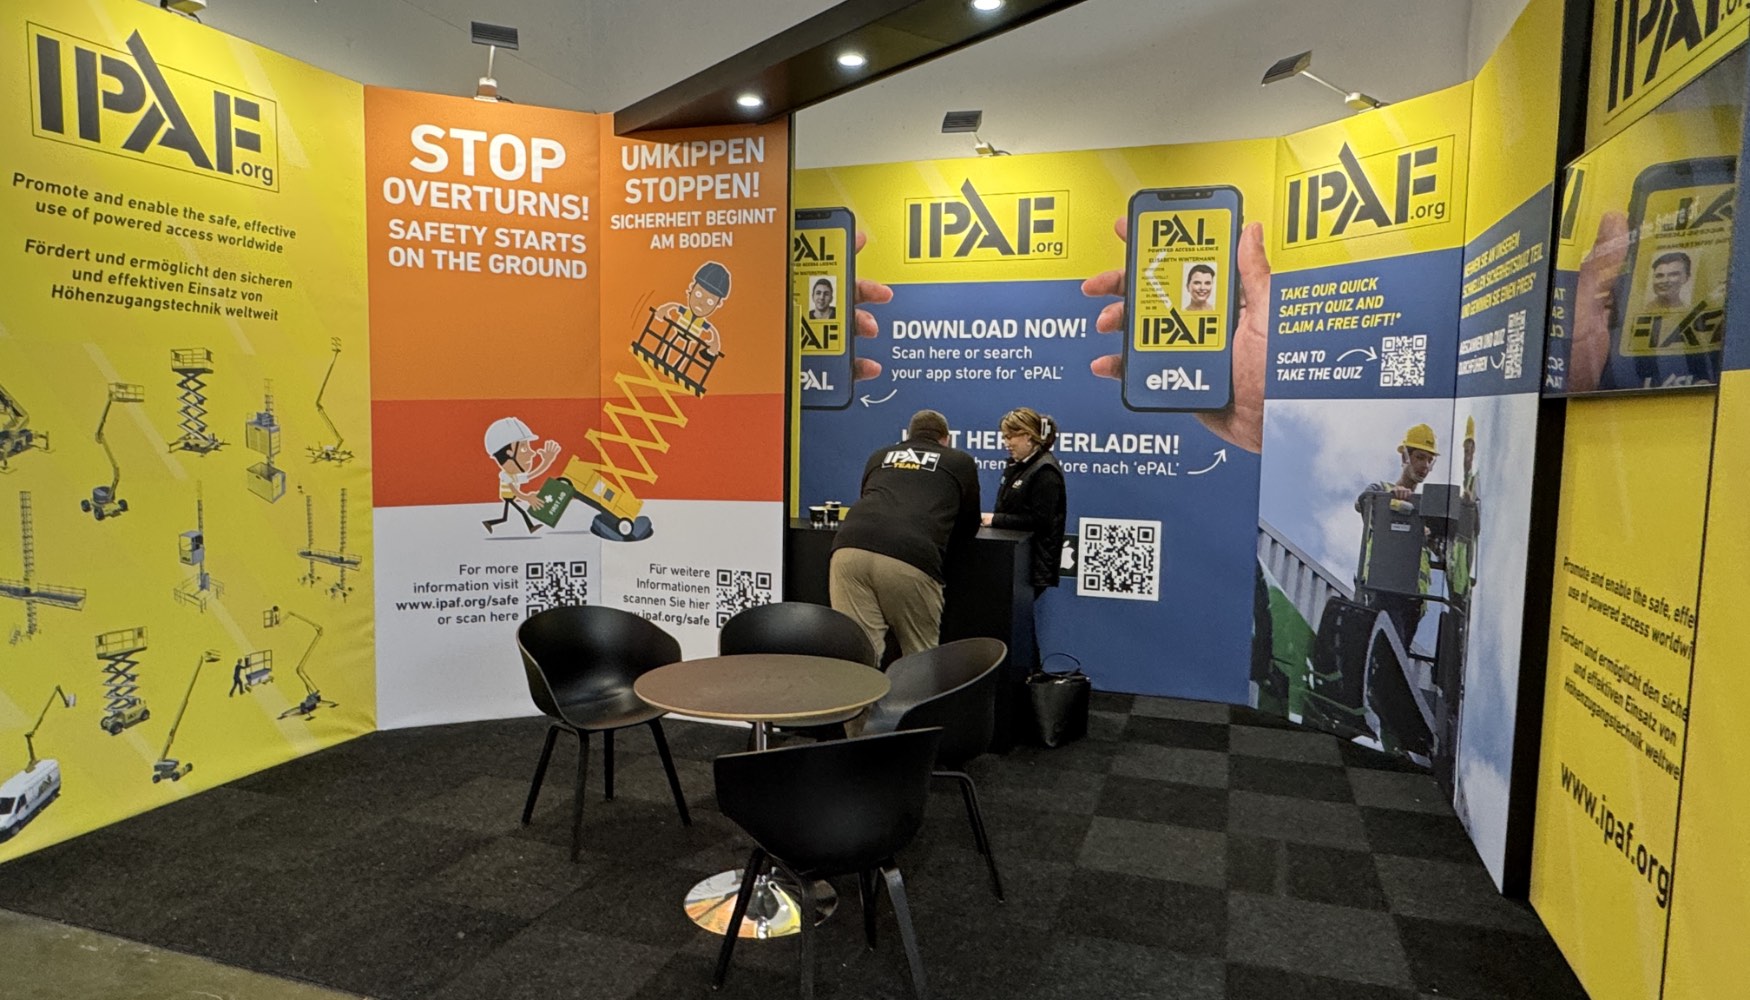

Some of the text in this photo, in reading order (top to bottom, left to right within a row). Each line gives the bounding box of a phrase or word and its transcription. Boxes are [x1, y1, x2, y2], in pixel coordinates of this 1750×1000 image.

[409, 124, 566, 183] STOP
[621, 136, 764, 171] UMKIPPEN
[383, 176, 589, 220] OVERTURNS!
[625, 172, 759, 204] STOPPEN!
[12, 172, 296, 240] Promote and enable the safe, effective
[35, 200, 284, 254] use of powered access worldwide
[610, 208, 777, 230] SICHERHEIT BEGINNT
[1152, 214, 1215, 247] PAL
[388, 218, 586, 253] SAFETY STARTS
[650, 232, 733, 249] AM BODEN
[24, 238, 293, 289] Fördert und ermöglicht den sicheren
[388, 246, 587, 279] ON THE GROUND
[72, 268, 263, 302] und effektiven Einsatz von
[1280, 277, 1380, 301] TAKE OUR QUICK
[51, 283, 278, 321] Höhenzugangstechnik weltweit
[1278, 295, 1384, 318] SAFETY QUIZ AND
[801, 316, 838, 349] AF
[893, 318, 1087, 339] DOWNLOAD NOW!
[1142, 307, 1218, 345] IPAF
[1278, 319, 1313, 335] CLAIM
[1311, 319, 1324, 332] A
[1326, 315, 1360, 331] FREE
[892, 345, 1032, 360] Scan here or search
[1277, 350, 1326, 365] SCAN TO
[892, 369, 921, 382] your
[926, 369, 951, 382] app
[955, 367, 992, 380] store
[996, 366, 1016, 380] for
[1146, 366, 1210, 391] ePAL
[1276, 365, 1364, 381] TAKE THE QUIZ
[883, 447, 938, 465] IPAF
[894, 462, 920, 470] TEAM
[1092, 461, 1128, 474] nach
[459, 564, 519, 575] For more
[650, 563, 710, 578] Für weitere
[413, 579, 519, 593] information visit
[636, 578, 710, 594] Informationen
[1563, 556, 1590, 581] Promote
[1590, 572, 1605, 588] and
[1605, 579, 1631, 600] enable
[1633, 587, 1647, 607] the
[1648, 597, 1671, 621] safe,
[396, 594, 519, 611] www.ipaf.org/safe
[623, 594, 710, 610] scannen Sie hier
[1568, 586, 1580, 600] use
[1580, 590, 1589, 604] of
[1588, 596, 1620, 622] powered
[1621, 612, 1650, 638] access
[437, 611, 519, 625] or scan here
[1584, 645, 1599, 662] und
[1599, 654, 1641, 691] ermöglicht
[1643, 679, 1660, 703] den
[1573, 663, 1677, 747] und effektiven Einsatz von
[1560, 762, 1671, 909] www.ipaf.org
